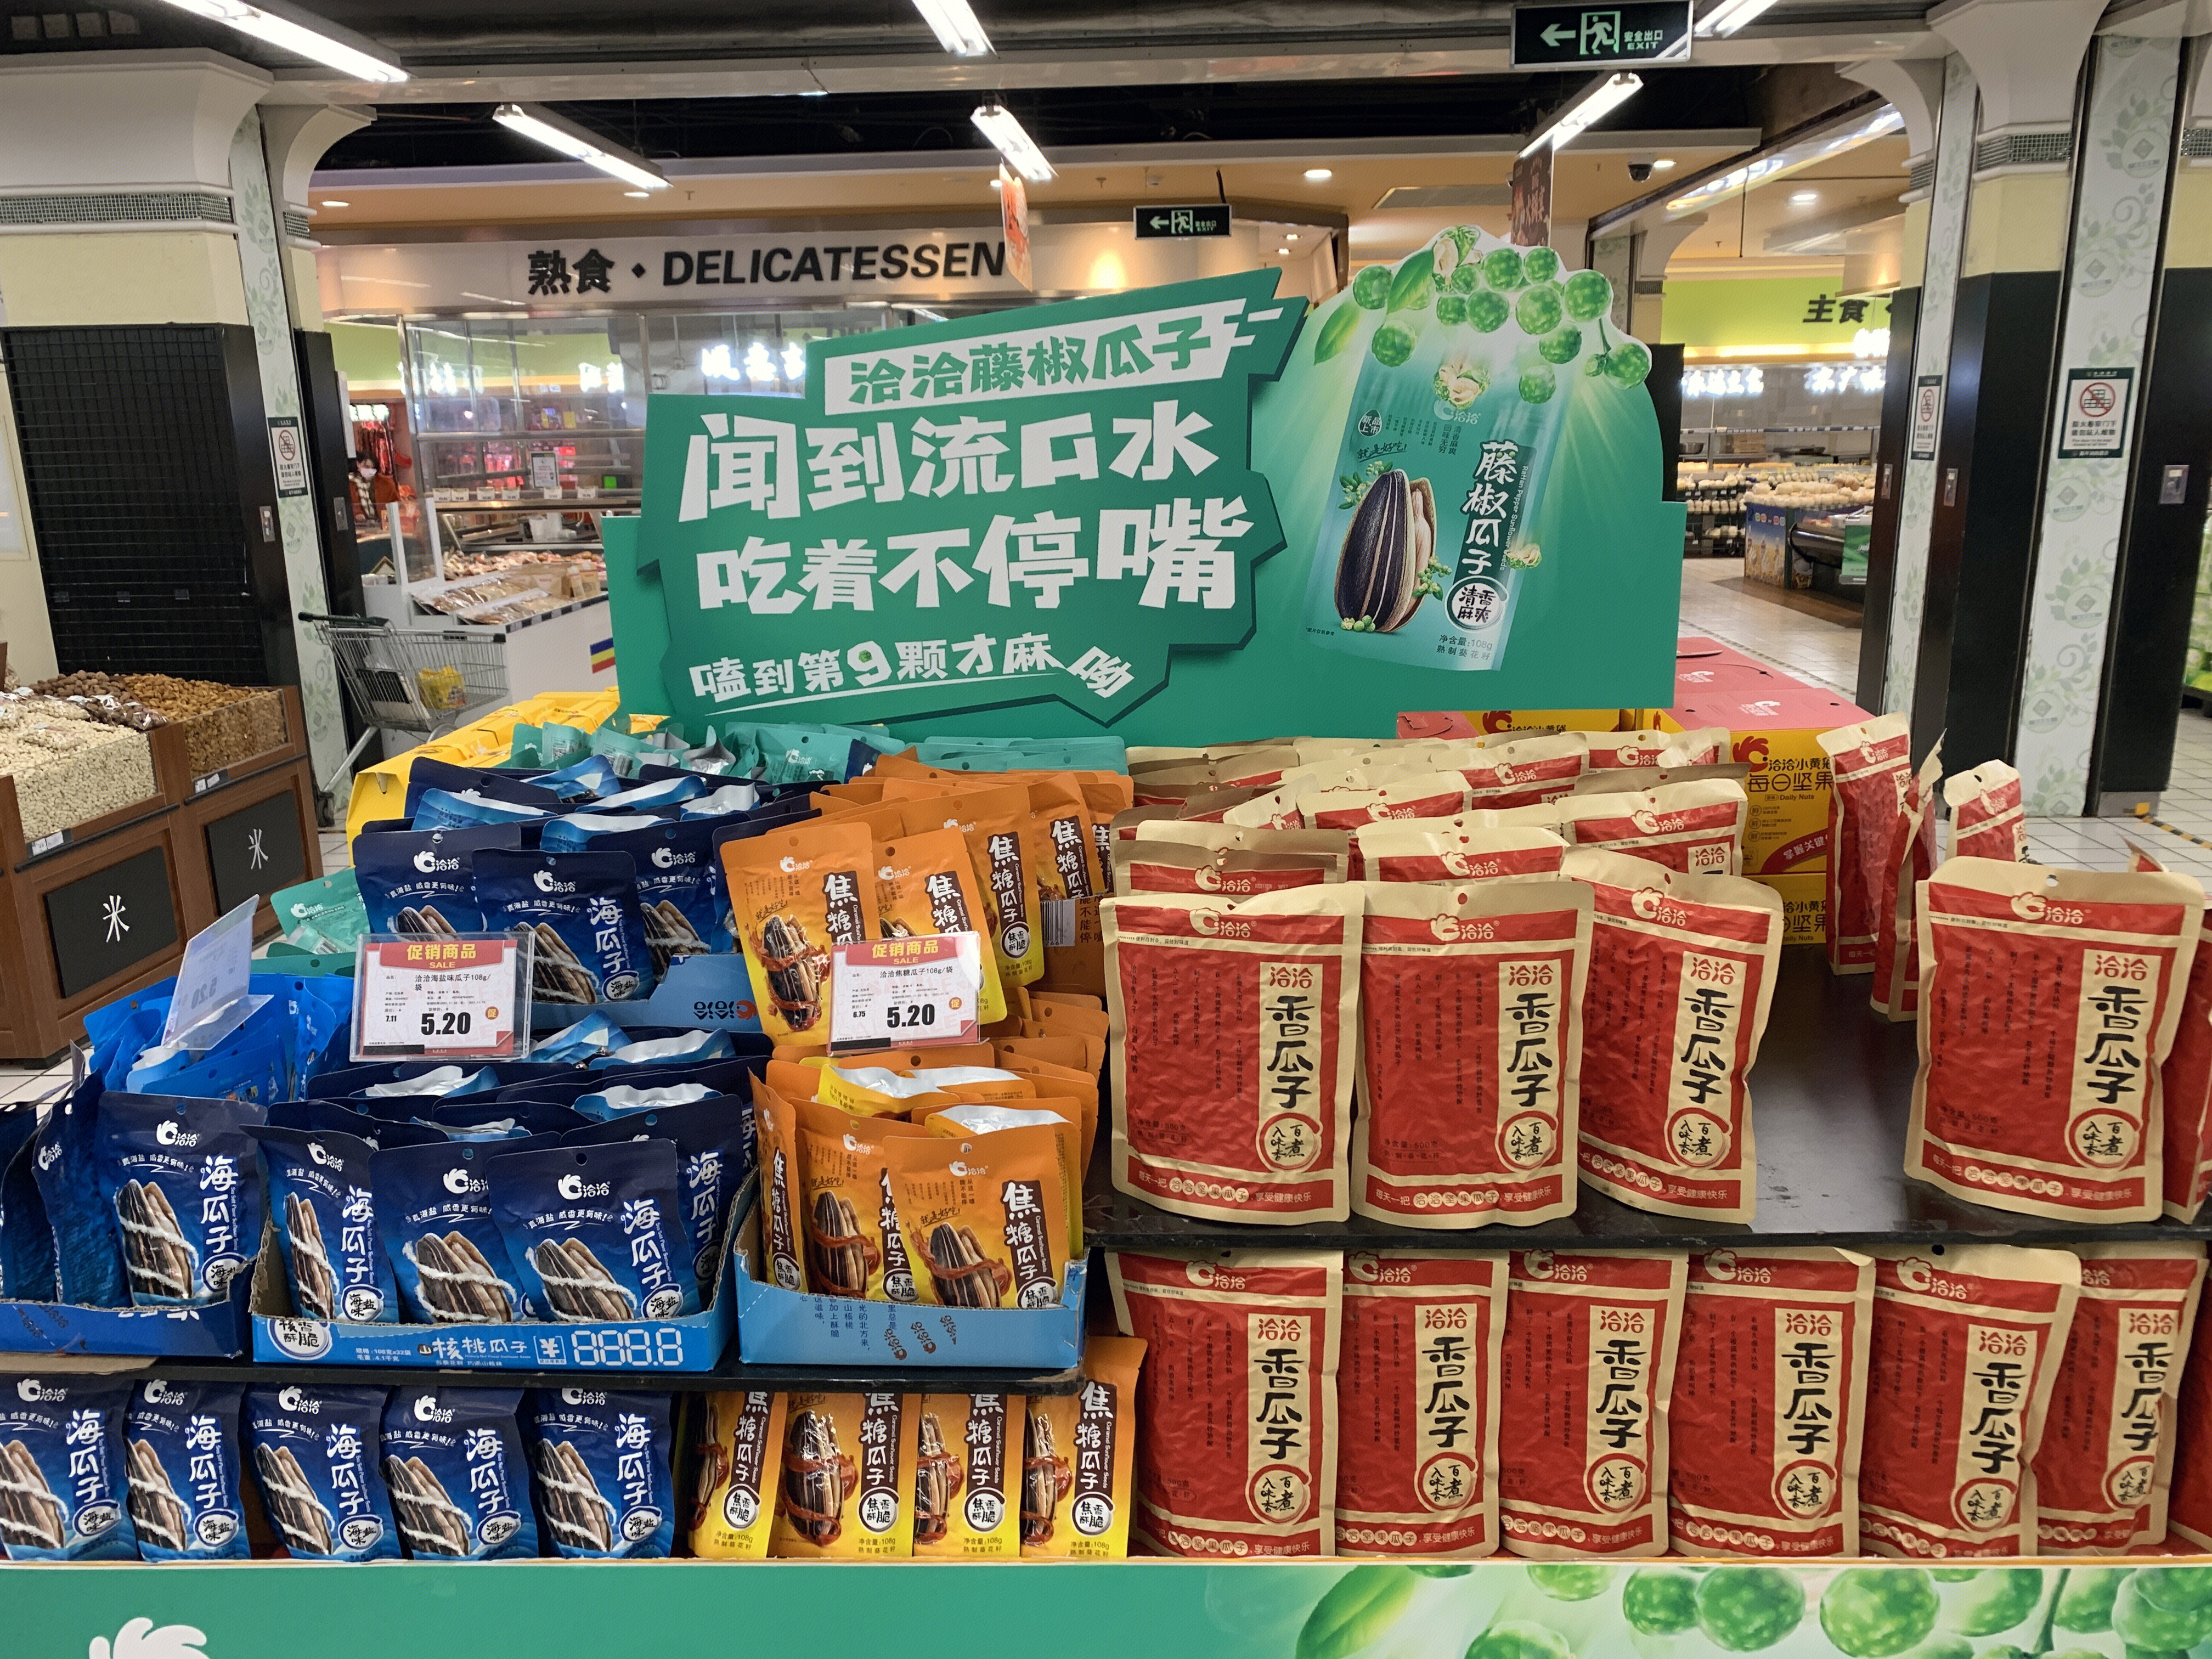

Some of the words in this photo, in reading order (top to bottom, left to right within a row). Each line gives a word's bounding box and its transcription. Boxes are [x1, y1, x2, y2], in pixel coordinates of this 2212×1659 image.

[1623, 30, 1663, 42] 安全出口
[1627, 42, 1658, 50] EXIT
[526, 249, 615, 295] 熟食
[663, 242, 1006, 286] DELICATESSEN
[1802, 294, 1870, 323] 主食
[848, 316, 1214, 404] 洽洽藤椒瓜子
[1362, 415, 1381, 425] 新品
[1454, 411, 1480, 425] 洽洽
[1360, 425, 1379, 435] 上市
[1439, 424, 1452, 454] 回味无穷
[1448, 425, 1462, 455] 清香麻爽
[679, 400, 1219, 522] 闻到流口水
[1357, 441, 1407, 459] 就是好吃!
[1460, 440, 1519, 575] 藤椒瓜子
[1513, 489, 1523, 513] Pepper
[1506, 514, 1518, 550] Sunflower
[697, 496, 1254, 614] 吃着不停嘴
[1499, 549, 1508, 572] eeds
[1436, 644, 1491, 661] 熟制葵花籽
[1438, 633, 1493, 651] 净含量:108g
[1511, 769, 1537, 782] 洽洽
[1747, 772, 1833, 792] 每日坚果
[1391, 806, 1416, 820] 洽洽
[1660, 817, 1685, 832] 洽洽
[673, 850, 696, 866] 洽洽
[1695, 846, 1725, 866] 洽洽
[1784, 834, 1828, 860] 掌握关键
[436, 856, 460, 872] 洽洽
[795, 861, 810, 872] 洽洽
[894, 867, 910, 879] 洽洽
[1469, 861, 1499, 876] 洽洽
[553, 877, 575, 893] 洽洽
[989, 835, 1020, 922] 焦糖瓜子
[1221, 878, 1251, 892] 洽洽
[306, 902, 323, 916] 洽洽
[1656, 907, 1687, 926] 洽洽
[2046, 907, 2085, 924] 洽洽
[586, 896, 623, 975] 海瓜子
[1220, 920, 1251, 938] 洽洽
[1460, 923, 1496, 940] 洽洽
[407, 944, 476, 960] 促销商品
[872, 939, 938, 959] 促销商品
[415, 974, 491, 982] 洽洽海盐味瓜子108g/
[880, 966, 953, 979] 洽洽焦糖瓜子108g/袋
[1271, 966, 1313, 989] 洽洽
[1509, 964, 1554, 986] 洽洽
[1690, 957, 1736, 986] 洽洽
[2095, 955, 2149, 981] 洽洽
[487, 1008, 497, 1018] 促
[693, 1001, 736, 1020] 洽洽
[695, 1001, 736, 1020] 洽洽
[951, 999, 960, 1008] 促
[421, 1012, 471, 1035] 5.20
[887, 1004, 935, 1028] 5.20
[1265, 995, 1315, 1109] 香瓜子
[1505, 992, 1555, 1107] 香瓜子
[1680, 988, 1735, 1105] 香瓜子
[2084, 986, 2142, 1104] 香瓜子
[176, 1133, 198, 1147] 洽洽
[1285, 1124, 1305, 1158] 百煮
[326, 1155, 343, 1171] 洽洽
[966, 1166, 986, 1175] 洽洽
[583, 1182, 610, 1197] 洽洽
[1138, 1170, 1167, 1188] 每天一把
[1169, 1177, 1249, 1203] 洽洽坚果瓜子
[1255, 1191, 1312, 1203] 享受健康快乐
[200, 1155, 238, 1254] 海瓜子
[689, 1152, 723, 1245] 海瓜子
[772, 1149, 787, 1251] 焦糖瓜子
[341, 1185, 373, 1284] 海瓜子
[1004, 1182, 1041, 1279] 焦糖瓜子
[620, 1198, 674, 1290] 海瓜子
[1215, 1274, 1246, 1290] 洽洽
[1379, 1267, 1411, 1283] 洽洽
[1554, 1266, 1588, 1282] 洽洽
[1737, 1266, 1771, 1284] 洽洽
[1931, 1280, 1968, 1300] 洽洽
[1258, 1318, 1302, 1342] 洽洽
[1424, 1307, 1468, 1330] 洽洽
[1600, 1310, 1645, 1334] 洽洽
[1785, 1312, 1833, 1336] 洽洽
[2129, 1312, 2175, 1335] 洽洽
[417, 1335, 528, 1359] 山核桃瓜子
[1979, 1330, 2028, 1357] 洽洽
[41, 1388, 66, 1402] 洽洽
[161, 1391, 185, 1406] 洽洽
[583, 1391, 606, 1406] 洽洽
[1254, 1348, 1305, 1460] 香瓜子
[1421, 1337, 1471, 1448] 香瓜子
[1595, 1340, 1647, 1448] 香瓜子
[1781, 1342, 1837, 1455] 香瓜子
[2121, 1342, 2174, 1452] 香瓜子
[299, 1400, 321, 1414] 洽洽
[432, 1408, 455, 1423] 洽洽
[1970, 1362, 2027, 1474] 香瓜子
[735, 1392, 769, 1482] 焦糖瓜子
[861, 1393, 899, 1486] 焦糖瓜子
[966, 1393, 1004, 1486] 焦糖瓜子
[1075, 1381, 1114, 1489] 焦糖瓜子
[66, 1409, 104, 1503] 海瓜子
[185, 1415, 222, 1509] 海瓜子
[616, 1413, 651, 1505] 海瓜子
[326, 1424, 362, 1515] 海瓜子
[464, 1428, 504, 1514] 海瓜子
[716, 1530, 753, 1544] 净含量:108g
[858, 1537, 896, 1546] 净含量:108g
[964, 1537, 1002, 1545] 净含量:108g
[1071, 1540, 1110, 1549] 净含量:108g
